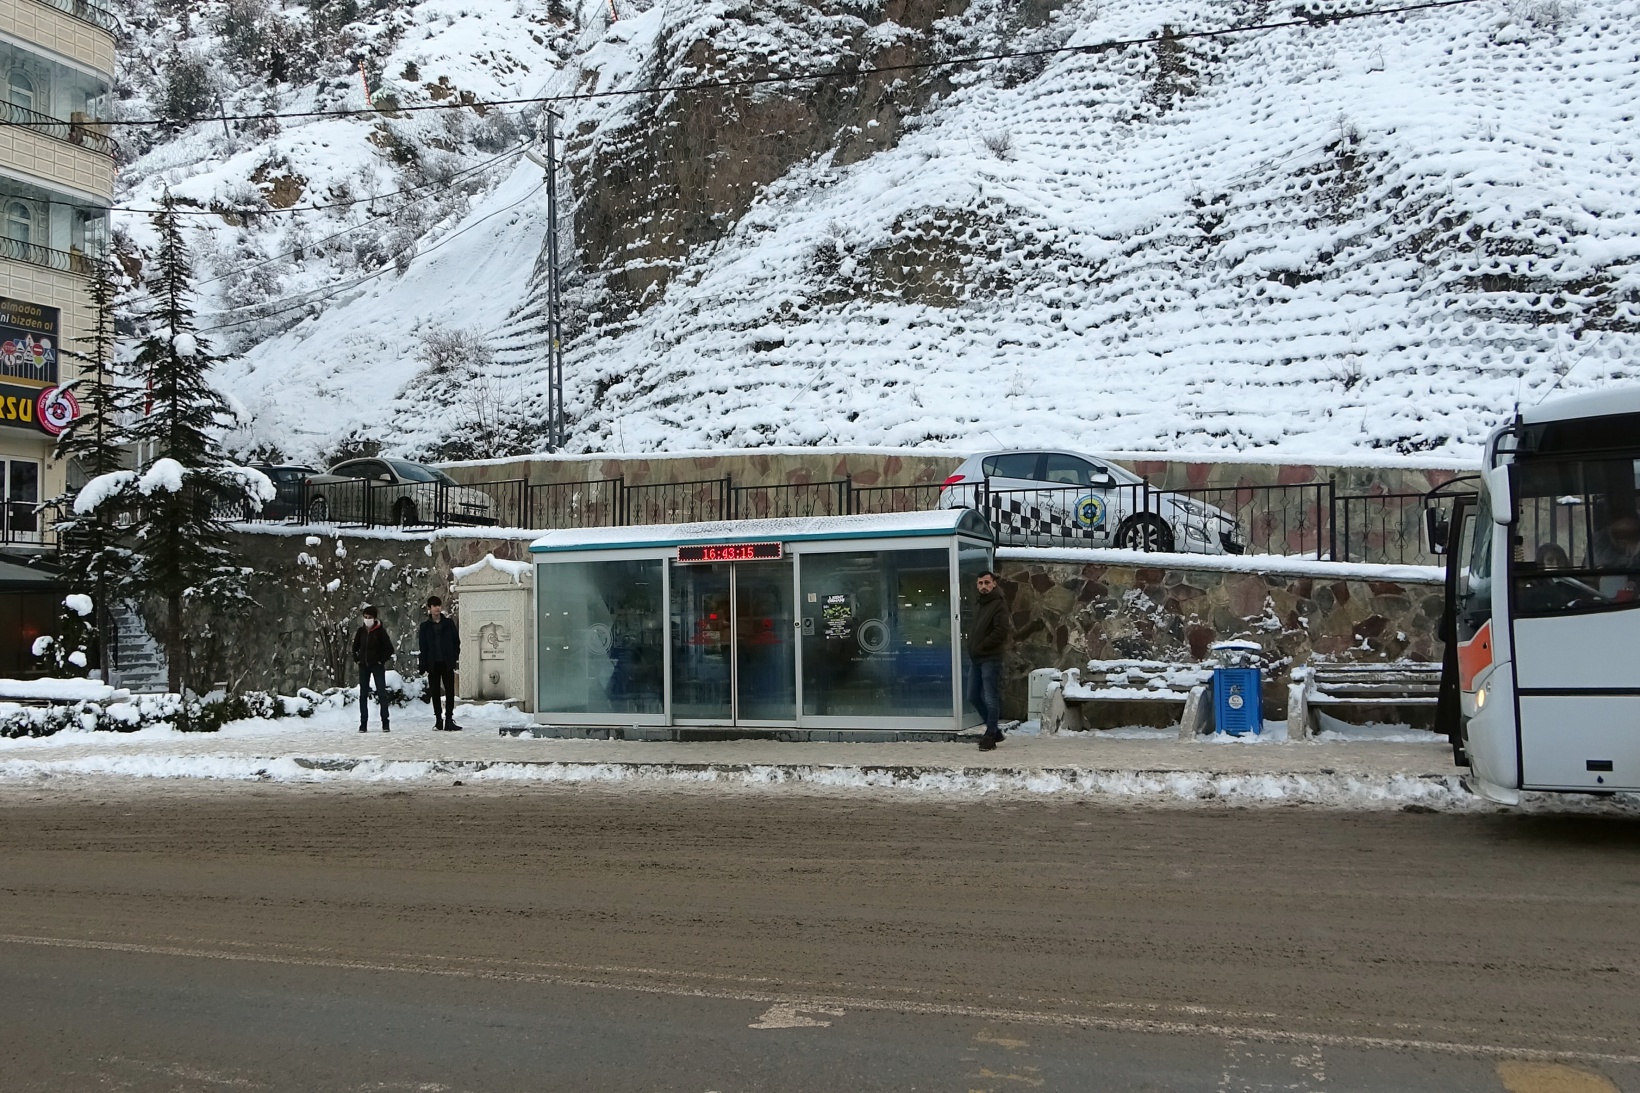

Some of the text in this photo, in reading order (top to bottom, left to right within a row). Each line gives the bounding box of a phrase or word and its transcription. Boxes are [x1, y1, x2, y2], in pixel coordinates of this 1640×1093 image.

[1, 302, 42, 316] almadan
[11, 315, 42, 328] bizden
[44, 322, 54, 331] al
[702, 547, 754, 560] 16:43:15
